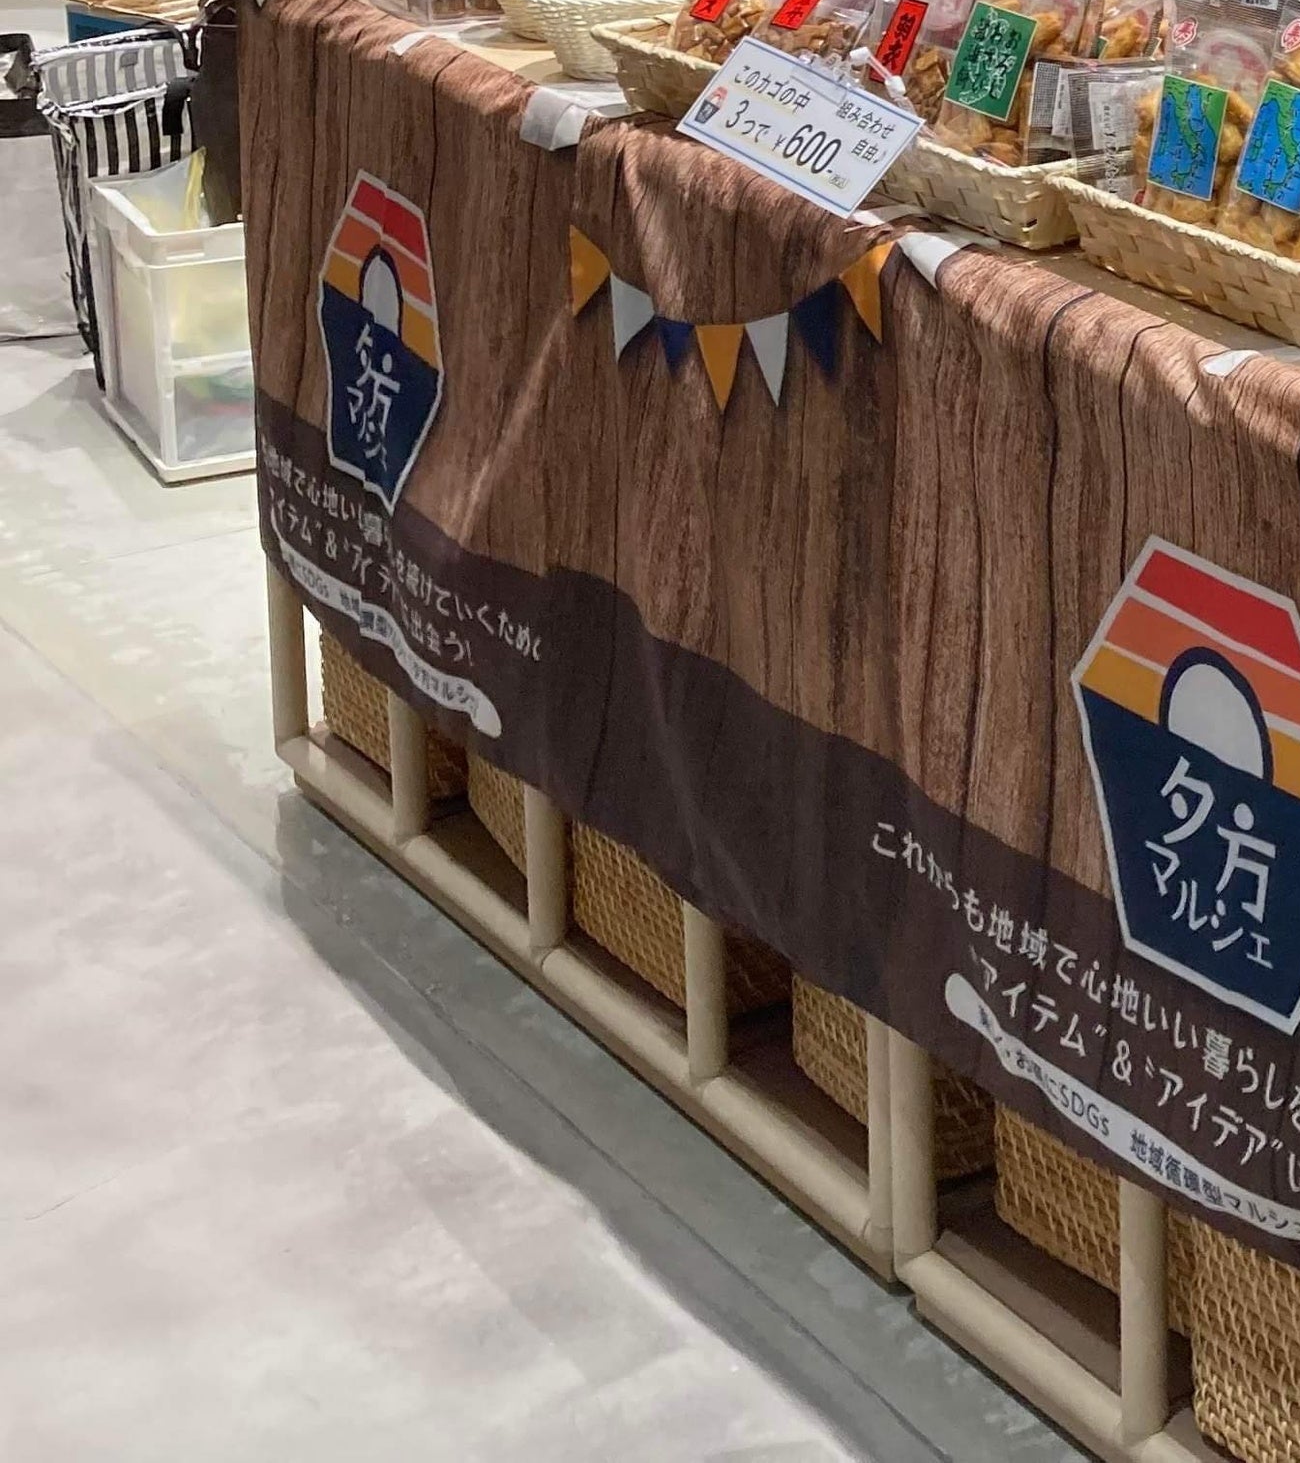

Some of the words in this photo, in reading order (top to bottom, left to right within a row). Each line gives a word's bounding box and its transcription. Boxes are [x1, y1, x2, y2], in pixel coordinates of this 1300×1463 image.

[725, 99, 771, 143] 3つで
[733, 64, 811, 114] このカゴの中
[836, 101, 895, 140] 組み合わせ
[1160, 755, 1277, 926] 夕方
[1143, 839, 1275, 972] マルシェ
